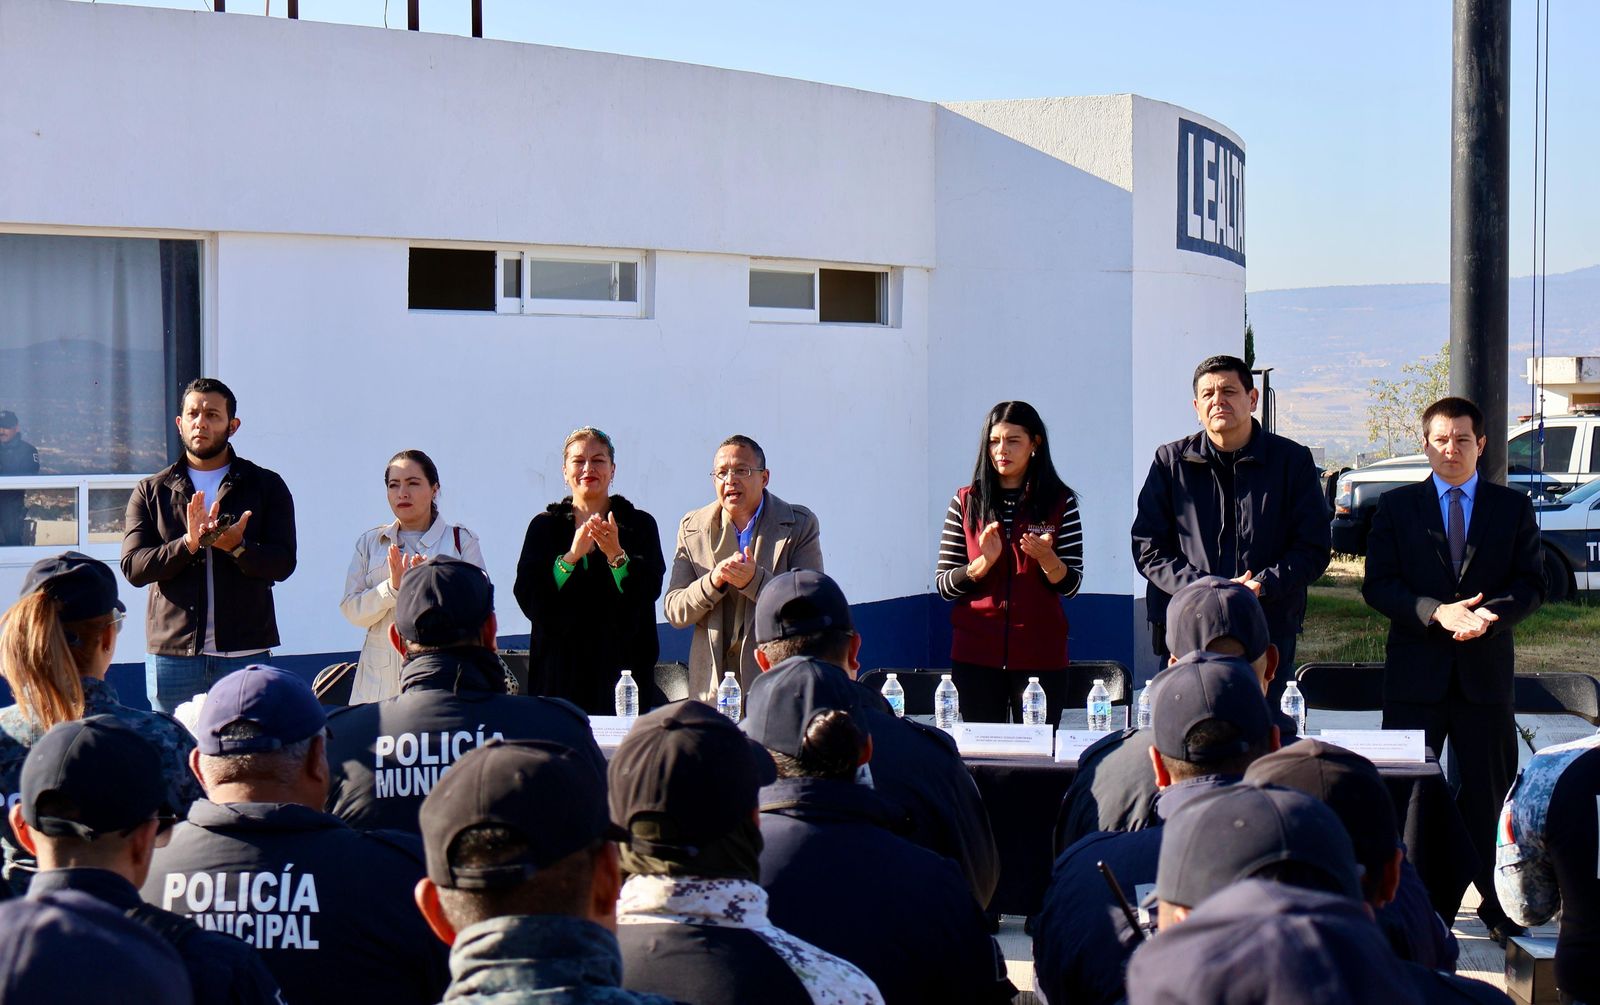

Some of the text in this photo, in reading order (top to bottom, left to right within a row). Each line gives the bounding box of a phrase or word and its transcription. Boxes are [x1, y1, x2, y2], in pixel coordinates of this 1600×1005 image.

[1187, 132, 1245, 254] LEALTA
[376, 723, 504, 768] POLICÍ
[375, 766, 452, 798] MUNI
[163, 863, 319, 912] POLICÍA
